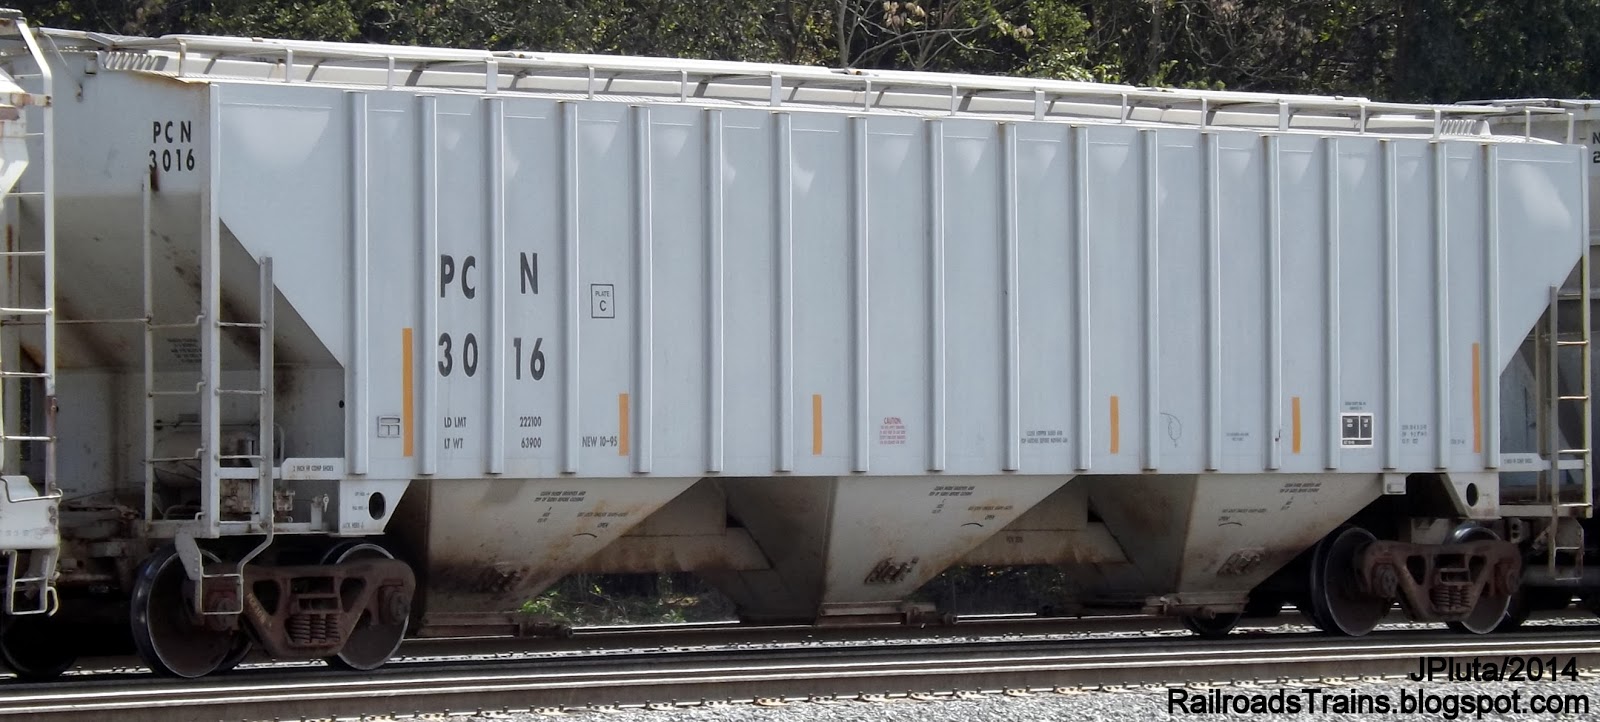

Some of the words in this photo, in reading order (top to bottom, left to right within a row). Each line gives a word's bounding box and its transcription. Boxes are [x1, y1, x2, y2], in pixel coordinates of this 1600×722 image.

[148, 148, 195, 172] 3016
[594, 290, 610, 298] PLATE
[599, 299, 607, 312] C
[443, 416, 453, 429] LD
[454, 416, 467, 428] LMT
[519, 415, 542, 428] 222100
[444, 437, 452, 450] LT
[453, 437, 465, 449] WT
[520, 436, 542, 449] 63900
[582, 436, 598, 448] NEW
[599, 435, 618, 447] 10-95
